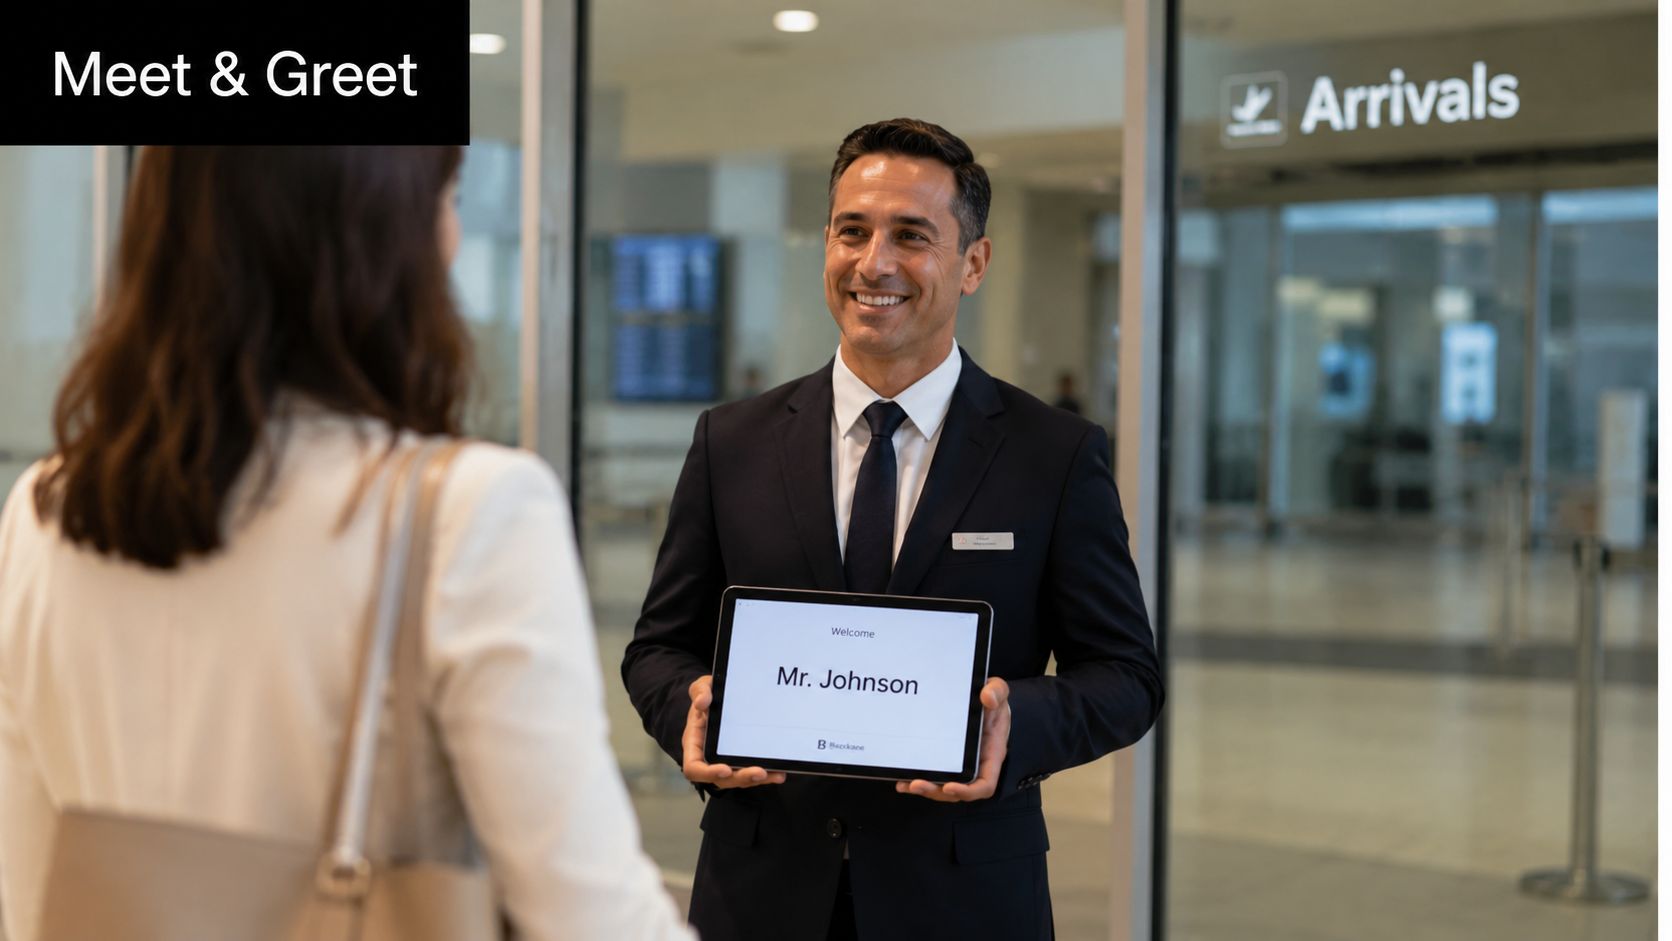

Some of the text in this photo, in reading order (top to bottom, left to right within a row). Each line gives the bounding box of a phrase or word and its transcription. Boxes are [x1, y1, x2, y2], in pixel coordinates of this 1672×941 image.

[1300, 61, 1520, 134] Arrivals
[831, 626, 875, 639] Welcome
[777, 666, 919, 695] Mr. Johnson
[816, 739, 827, 752] B
